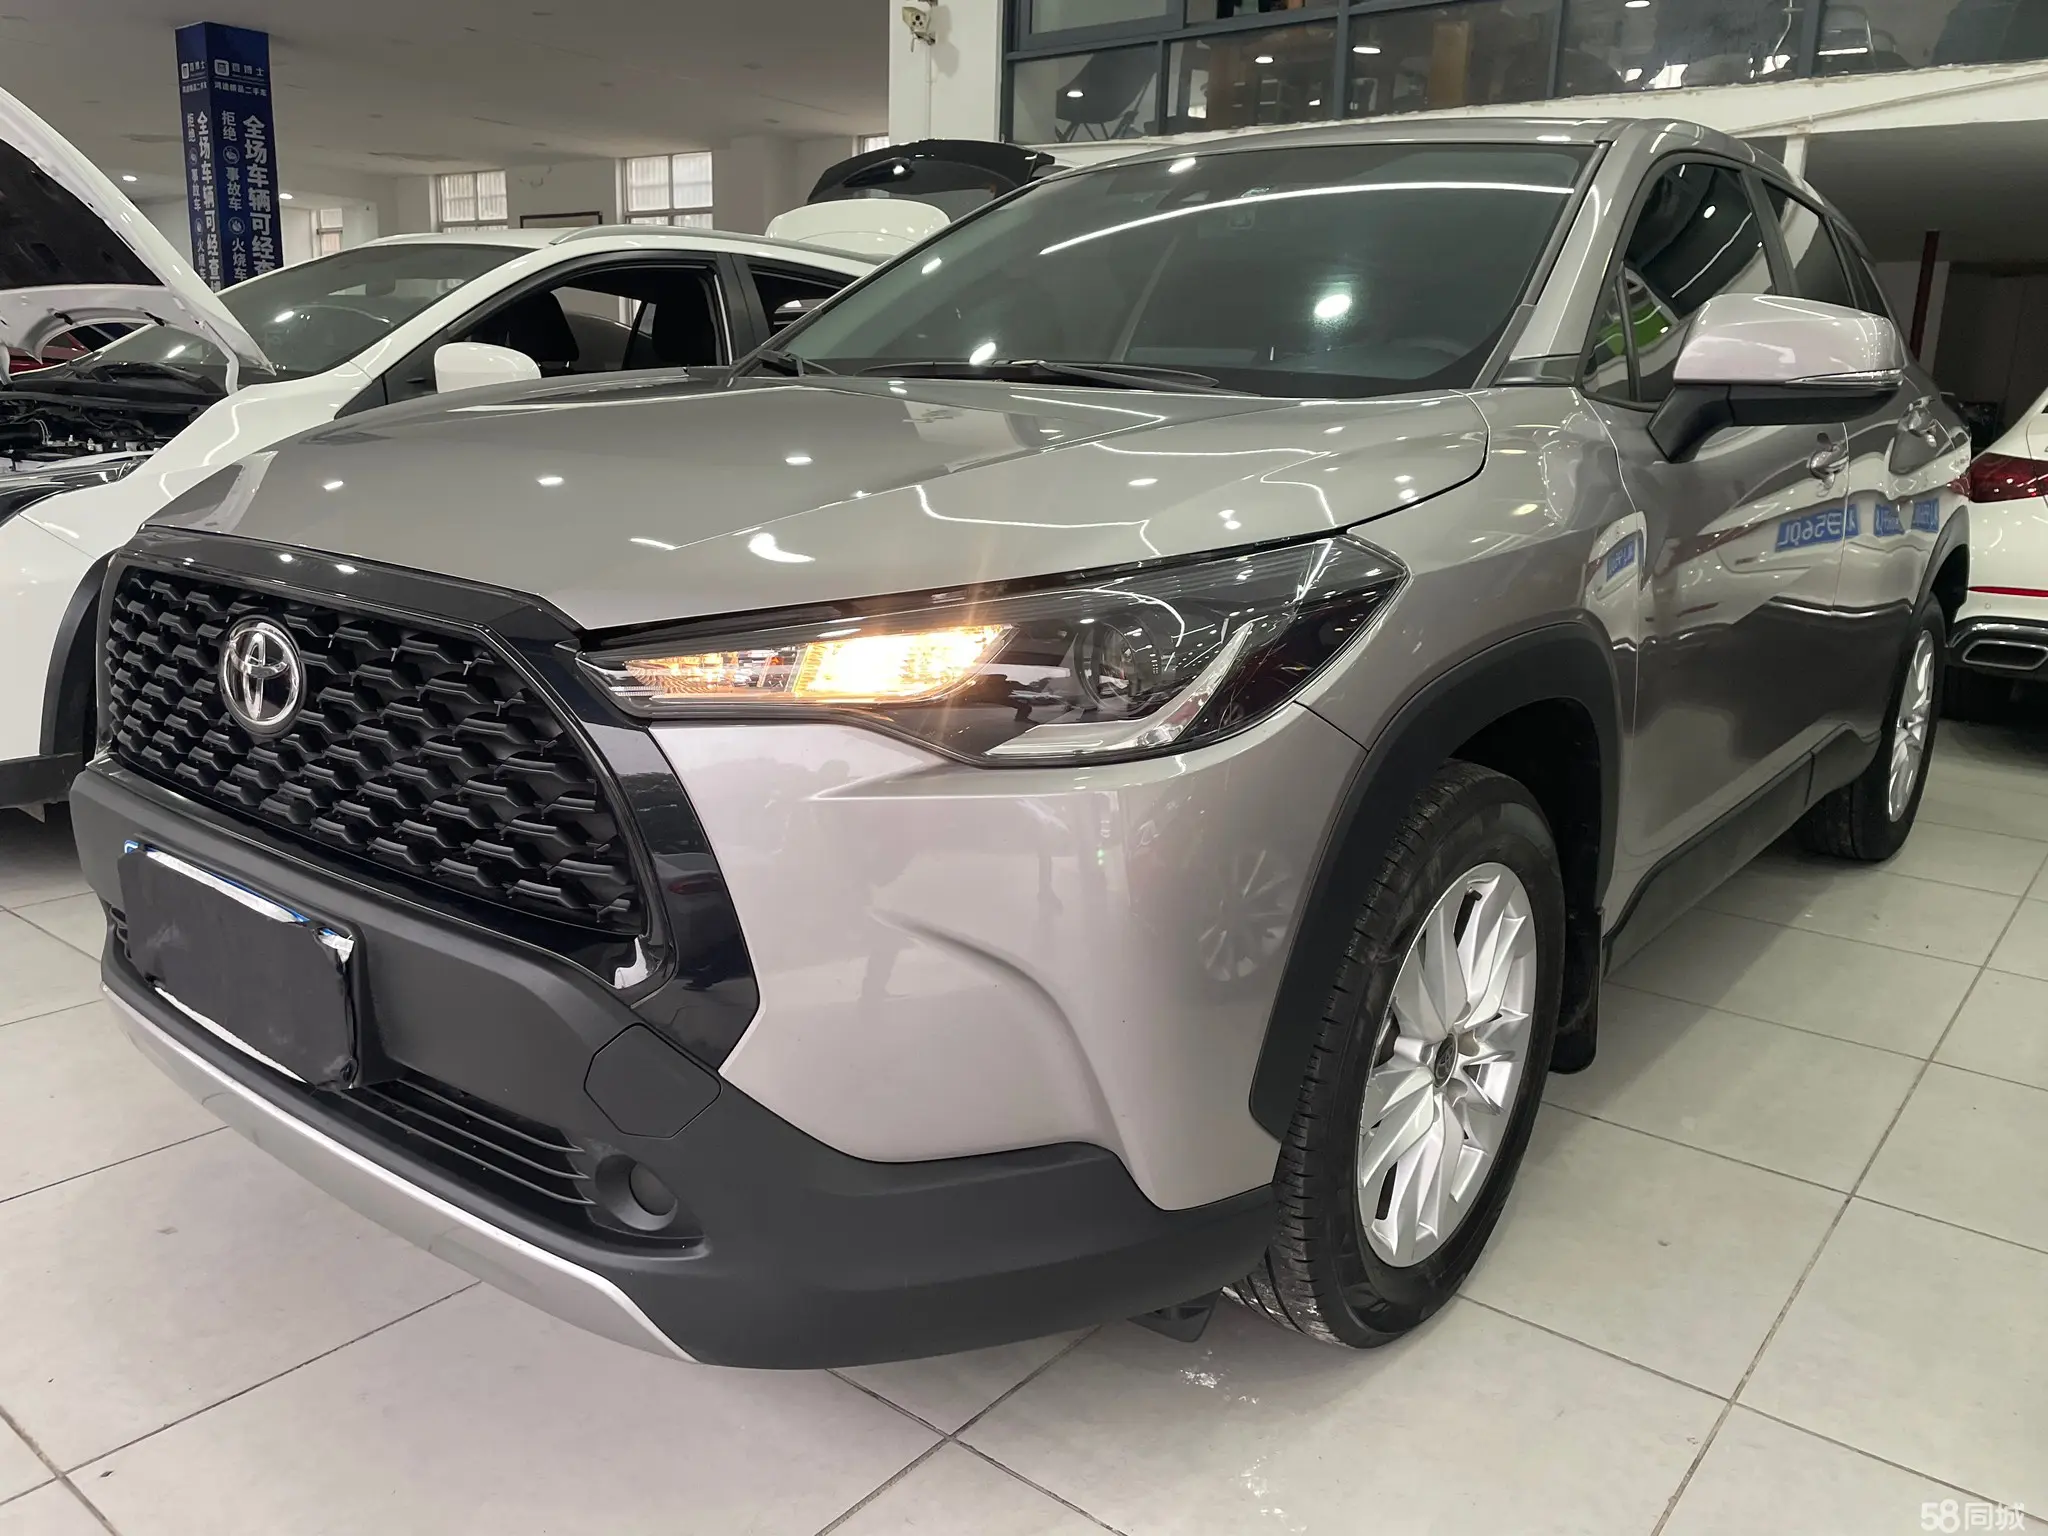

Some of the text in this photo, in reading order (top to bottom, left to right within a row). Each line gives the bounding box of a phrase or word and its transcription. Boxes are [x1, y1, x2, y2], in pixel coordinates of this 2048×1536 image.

[222, 110, 247, 280] 拒绝 事故车 火烧车
